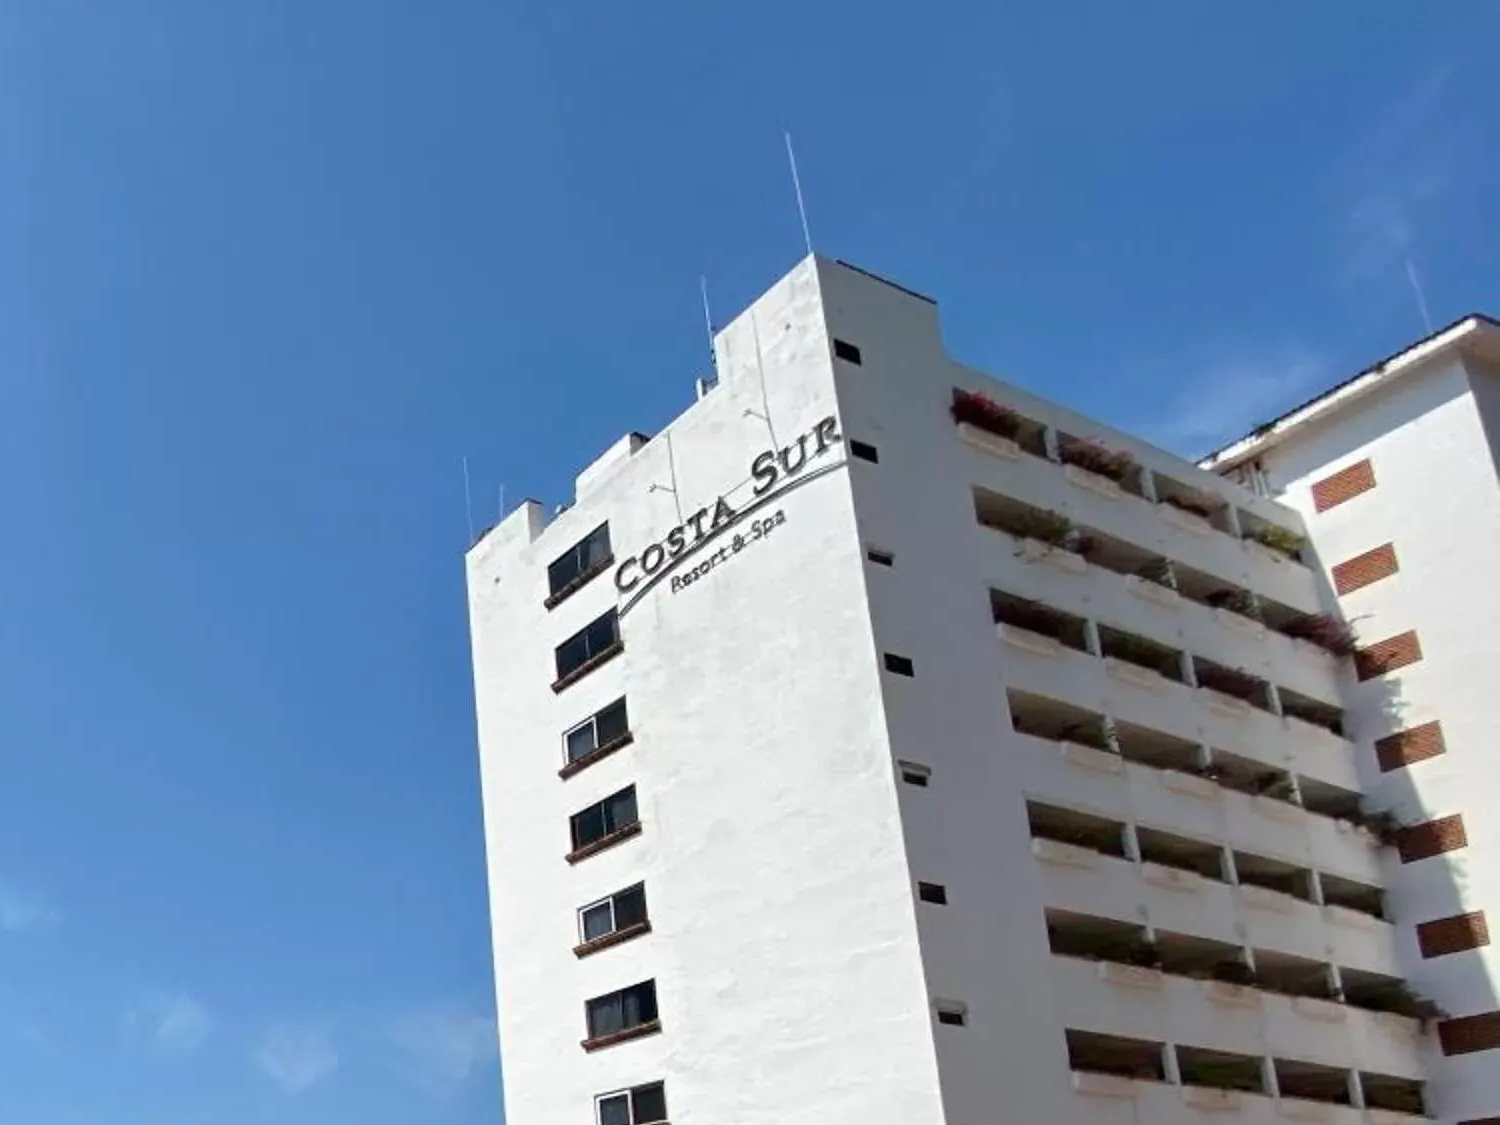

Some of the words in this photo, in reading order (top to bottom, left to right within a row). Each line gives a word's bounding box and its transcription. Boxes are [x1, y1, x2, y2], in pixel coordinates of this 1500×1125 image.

[614, 496, 736, 593] COSTA
[751, 416, 842, 495] SUR
[671, 547, 726, 593] Resort
[732, 533, 746, 552] &
[750, 510, 786, 542] Spa
